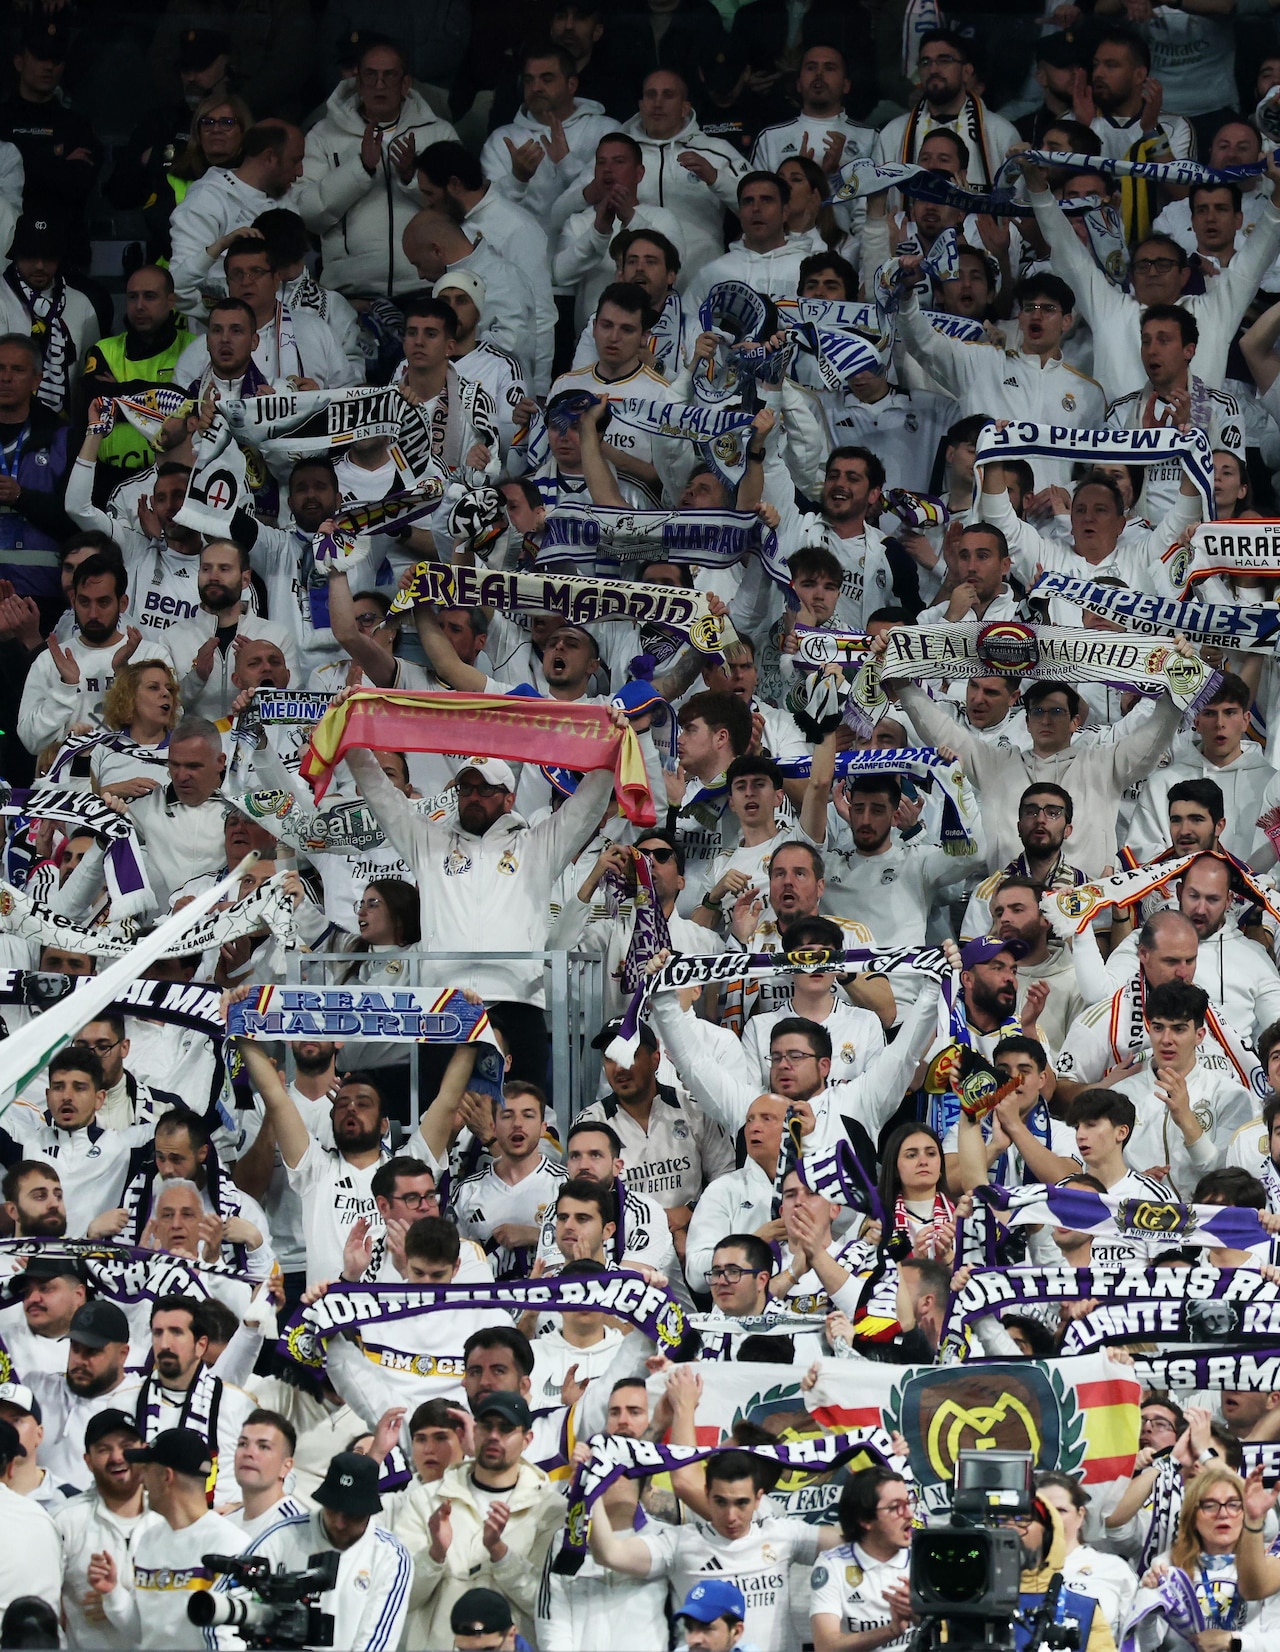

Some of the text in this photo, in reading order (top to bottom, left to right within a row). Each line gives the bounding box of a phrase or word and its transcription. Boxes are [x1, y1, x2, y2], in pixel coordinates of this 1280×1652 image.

[255, 396, 297, 425] JUDE
[1050, 425, 1161, 449] Madrid
[1221, 425, 1242, 449] hp
[1235, 558, 1270, 567] HALA
[427, 562, 698, 627] REAL MADRID
[603, 581, 634, 591] DEL
[639, 586, 692, 597] SIGLO
[1033, 571, 1265, 637] CAMPEONES
[1044, 589, 1084, 609] COMO
[1086, 600, 1109, 617] NO
[1110, 610, 1129, 625] TE
[1131, 617, 1162, 637] VOY
[1181, 630, 1241, 648] QUERER
[892, 633, 1139, 668] REAL MADRID
[932, 661, 979, 675] ESTADIO
[983, 666, 1034, 676] SANTIAGO
[852, 761, 912, 770] CAMPEONES
[325, 833, 373, 847] Santiago
[182, 932, 216, 950] LEAGUE
[279, 989, 423, 1012] REAL
[242, 1008, 463, 1039] MADRID
[648, 1175, 682, 1193] BETTER
[629, 1228, 648, 1252] hp
[1091, 1267, 1222, 1299] FANS
[556, 1277, 667, 1324] RMCF
[380, 1353, 412, 1372] RM
